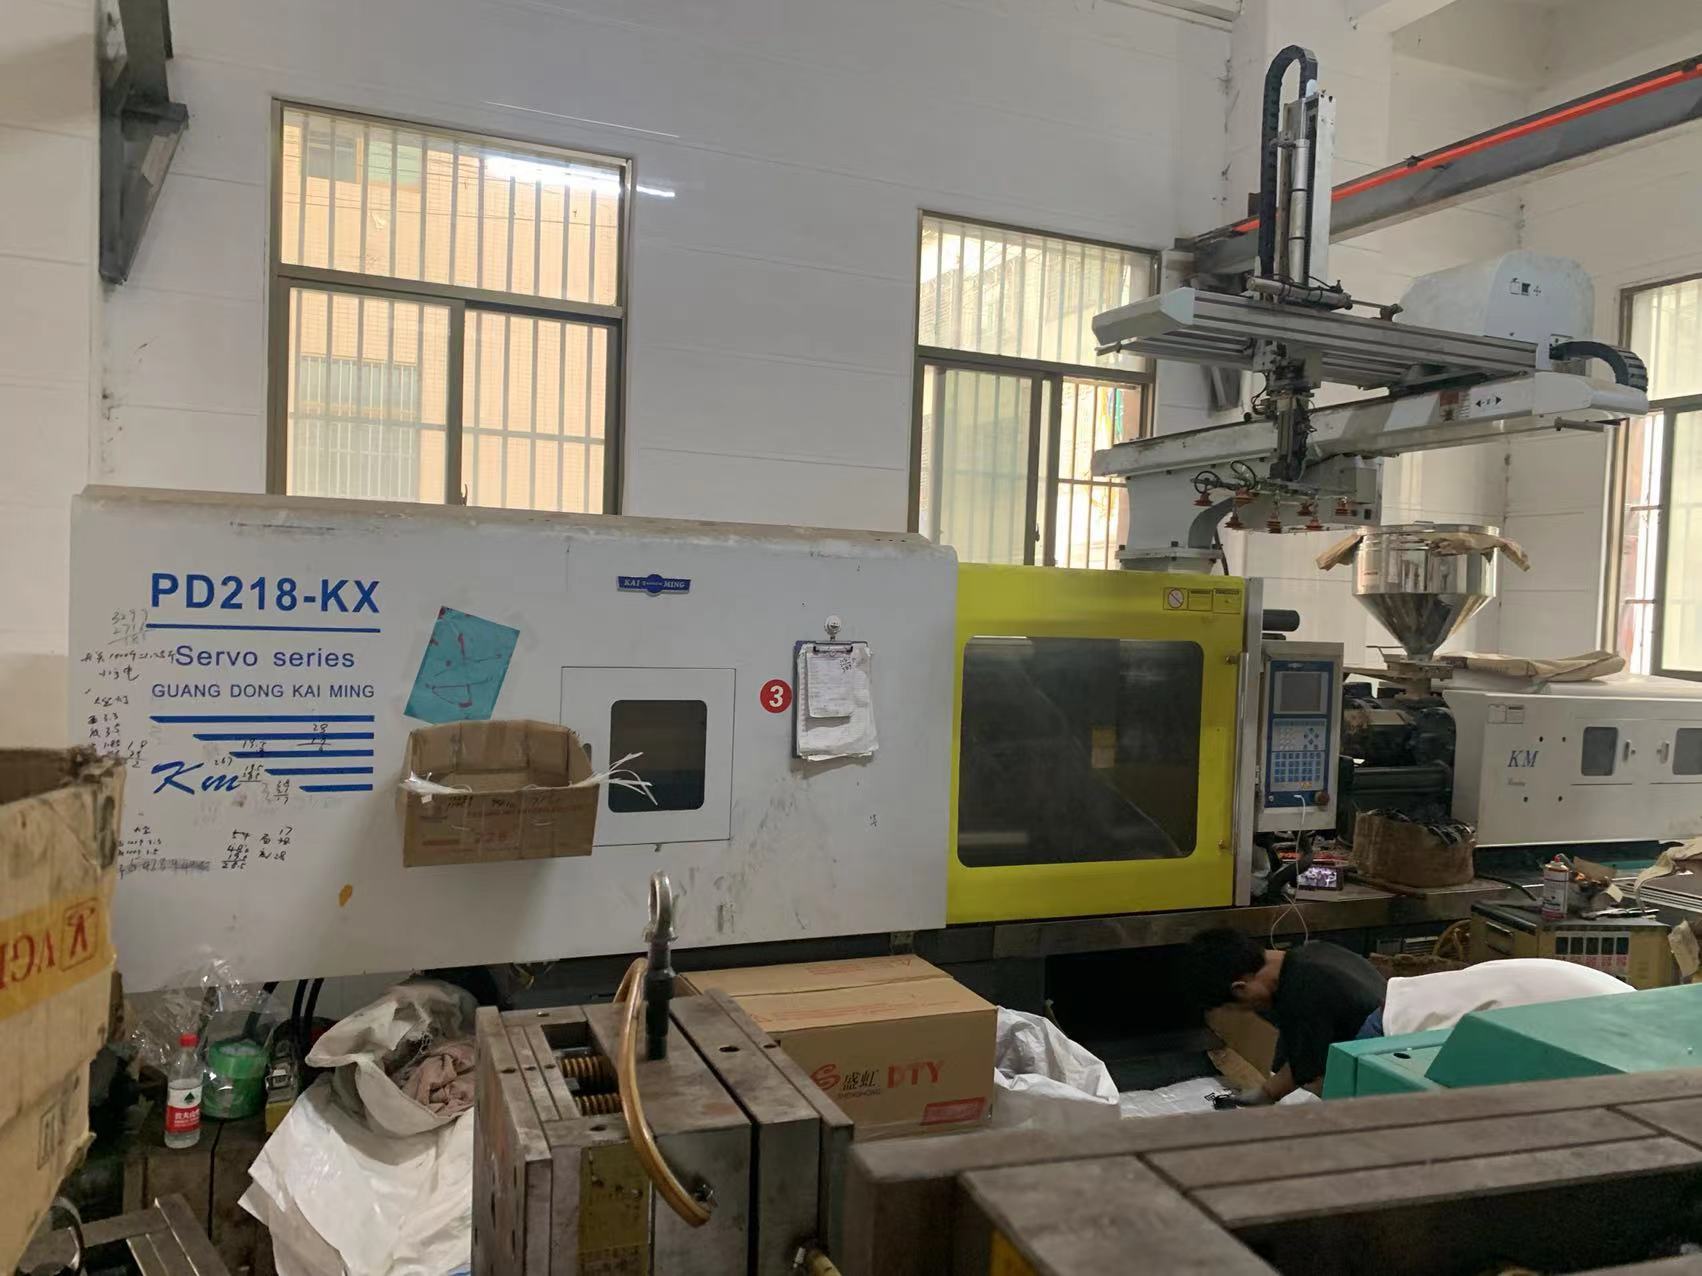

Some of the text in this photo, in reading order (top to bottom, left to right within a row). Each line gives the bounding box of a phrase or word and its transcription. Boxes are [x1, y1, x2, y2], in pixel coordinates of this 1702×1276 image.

[151, 573, 381, 613] PD218-KX
[624, 579, 641, 587] KAI
[664, 580, 686, 588] MING
[175, 645, 259, 667] Servo
[273, 647, 355, 668] series
[151, 683, 375, 698] GUANG DONG KAI MING
[768, 685, 785, 708] 3
[1507, 750, 1540, 767] KM
[151, 761, 241, 795] Km
[887, 1060, 944, 1088] DTY
